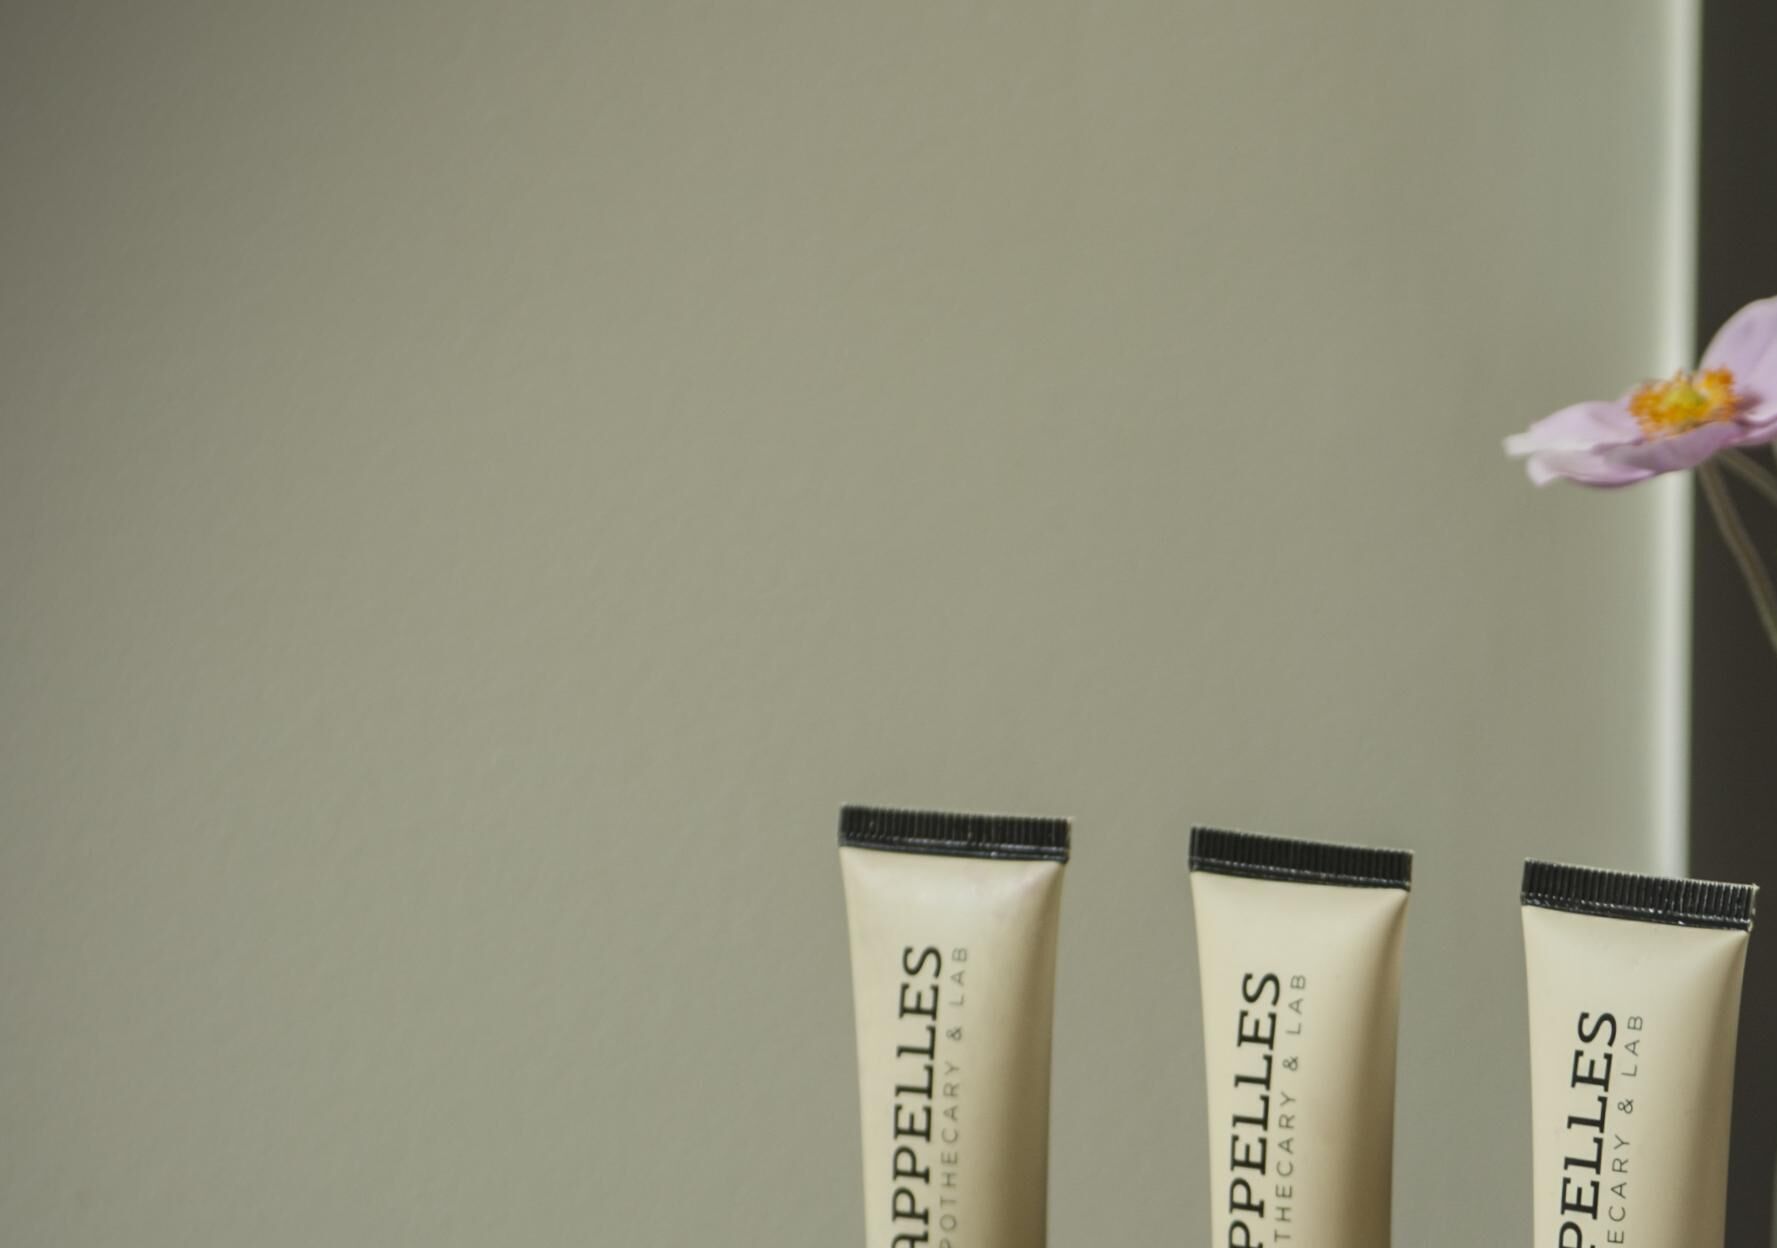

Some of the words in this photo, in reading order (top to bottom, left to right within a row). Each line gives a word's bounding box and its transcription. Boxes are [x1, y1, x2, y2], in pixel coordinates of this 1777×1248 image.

[948, 946, 968, 1007] LAB
[1286, 974, 1307, 1035] LAB
[946, 1025, 962, 1041] &
[1621, 1014, 1643, 1077] LAB
[1282, 1056, 1299, 1071] &
[1617, 1098, 1634, 1114] &
